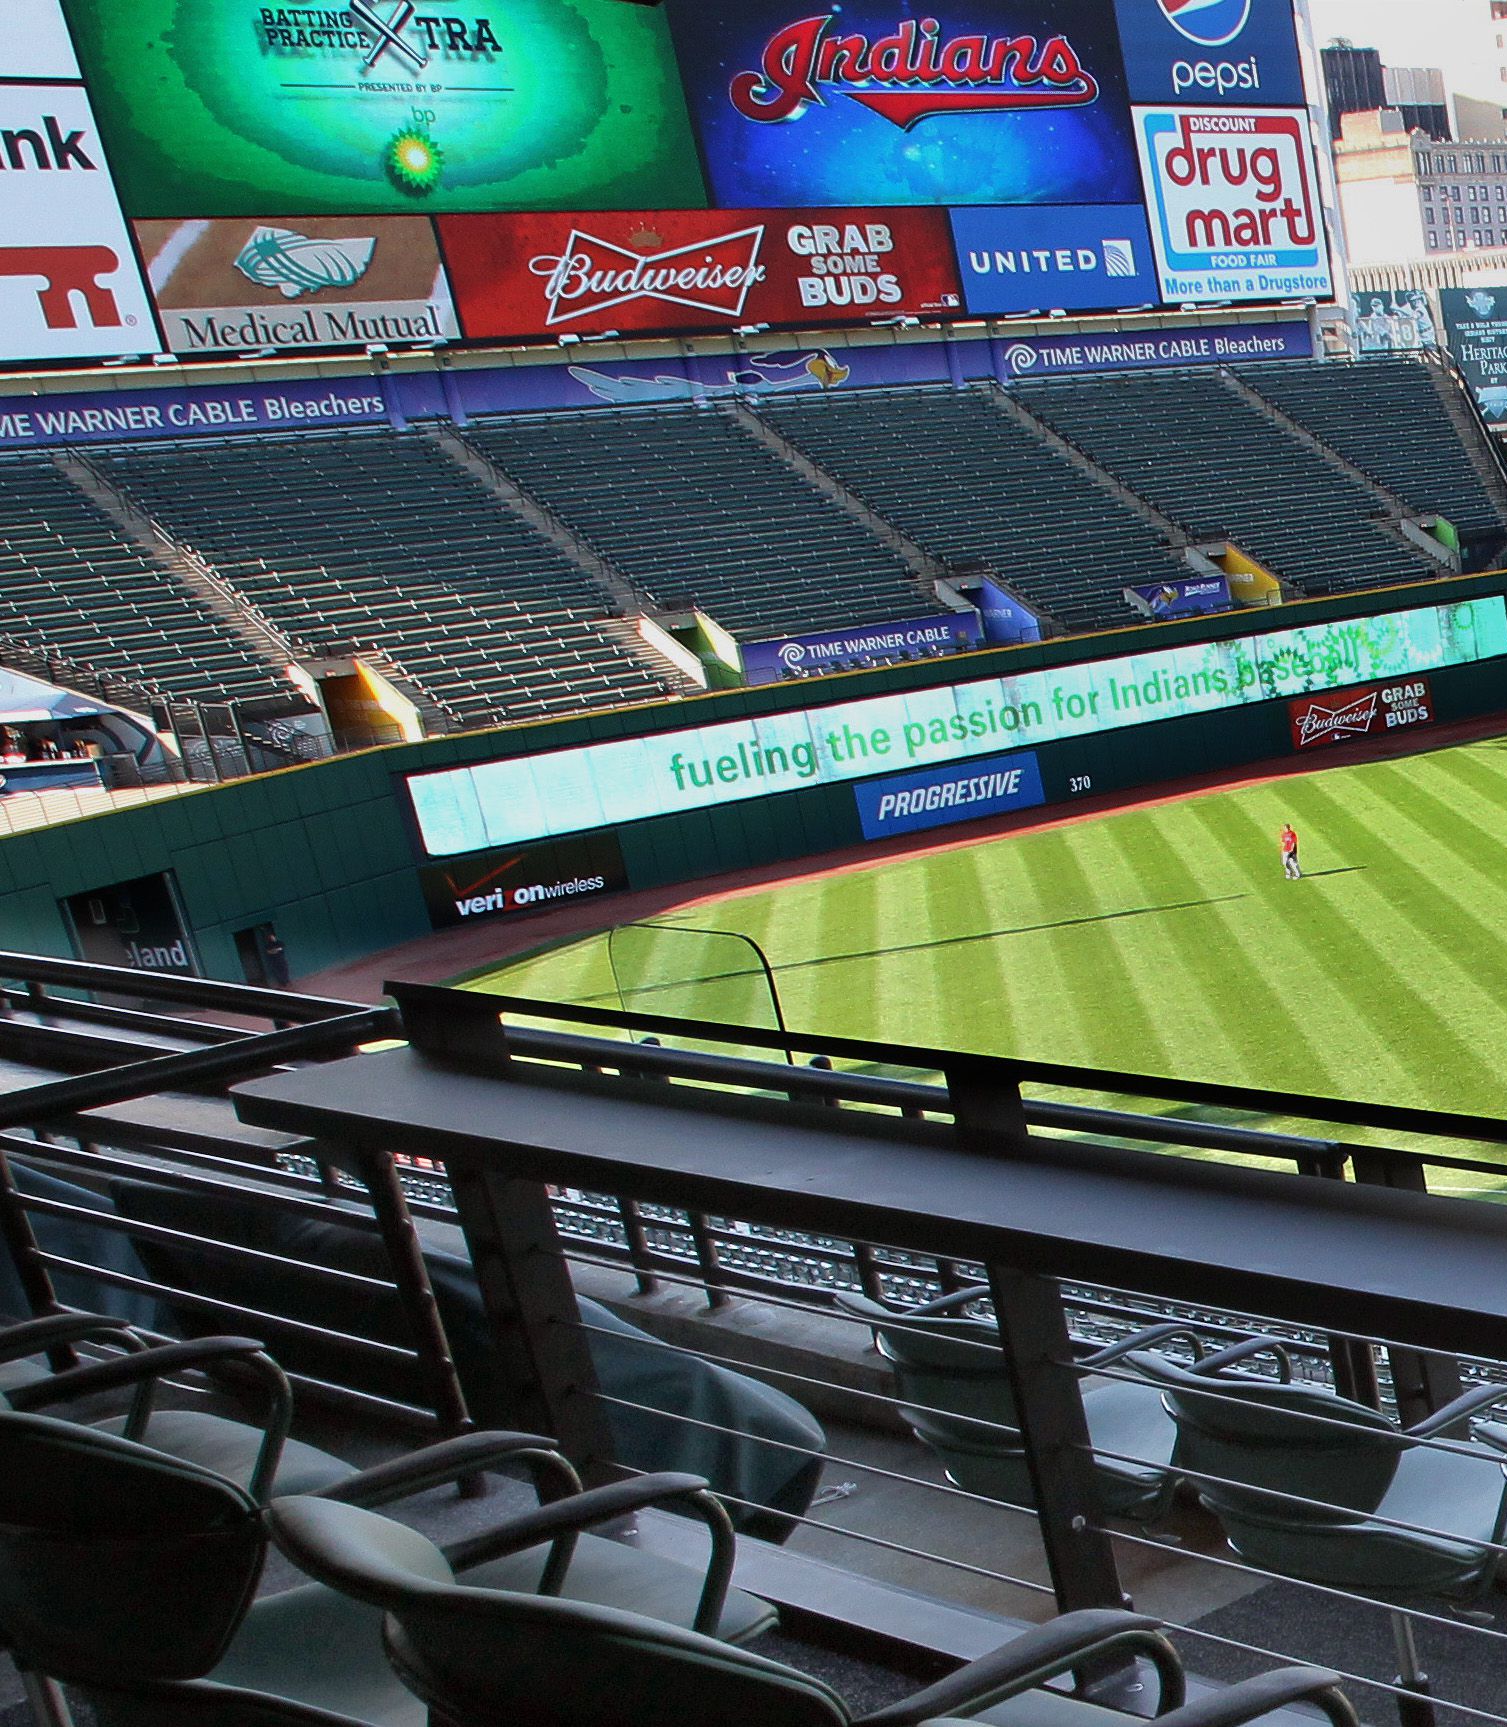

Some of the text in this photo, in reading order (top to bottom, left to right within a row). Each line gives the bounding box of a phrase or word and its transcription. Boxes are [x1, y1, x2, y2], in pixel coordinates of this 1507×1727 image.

[260, 8, 354, 28] BATTING
[266, 28, 371, 49] PRACTICE
[729, 14, 1099, 124] Indians
[1172, 57, 1260, 95] pepsi
[358, 82, 443, 93] PRESENTED BY BP
[411, 106, 436, 125] bp
[1189, 117, 1256, 133] DISCOUNT
[0, 115, 97, 171] nk
[1165, 136, 1282, 202] drug
[1186, 197, 1316, 248] mart
[788, 224, 894, 255] GRAB
[529, 250, 766, 300] Budweiser
[812, 254, 881, 274] SOME
[969, 249, 1097, 274] UNITED
[1210, 254, 1278, 268] FOOD FAIR
[798, 274, 902, 307] BUDS
[1165, 273, 1328, 295] More than a Drugstore
[183, 305, 442, 348] Medical Mutual
[1039, 336, 1285, 367] TIME WARNER CABLE Bleachers
[1480, 360, 1507, 376] PARK
[36, 405, 164, 436] WARNER
[168, 399, 257, 428] CABLE
[265, 392, 386, 421] Bleachers
[807, 626, 950, 659] TIME WARNER CABLE
[1381, 682, 1426, 701] GRAB
[1391, 699, 1419, 711] SOME
[670, 741, 819, 791] fueling
[827, 723, 891, 763] the
[904, 699, 1043, 759] passion
[1052, 685, 1098, 722] for
[1109, 667, 1228, 711] Indians
[1296, 705, 1378, 735] Budweiser
[1386, 706, 1429, 728] BUDS
[878, 768, 1024, 821] PROGRESSIVE
[1068, 775, 1091, 792] 370
